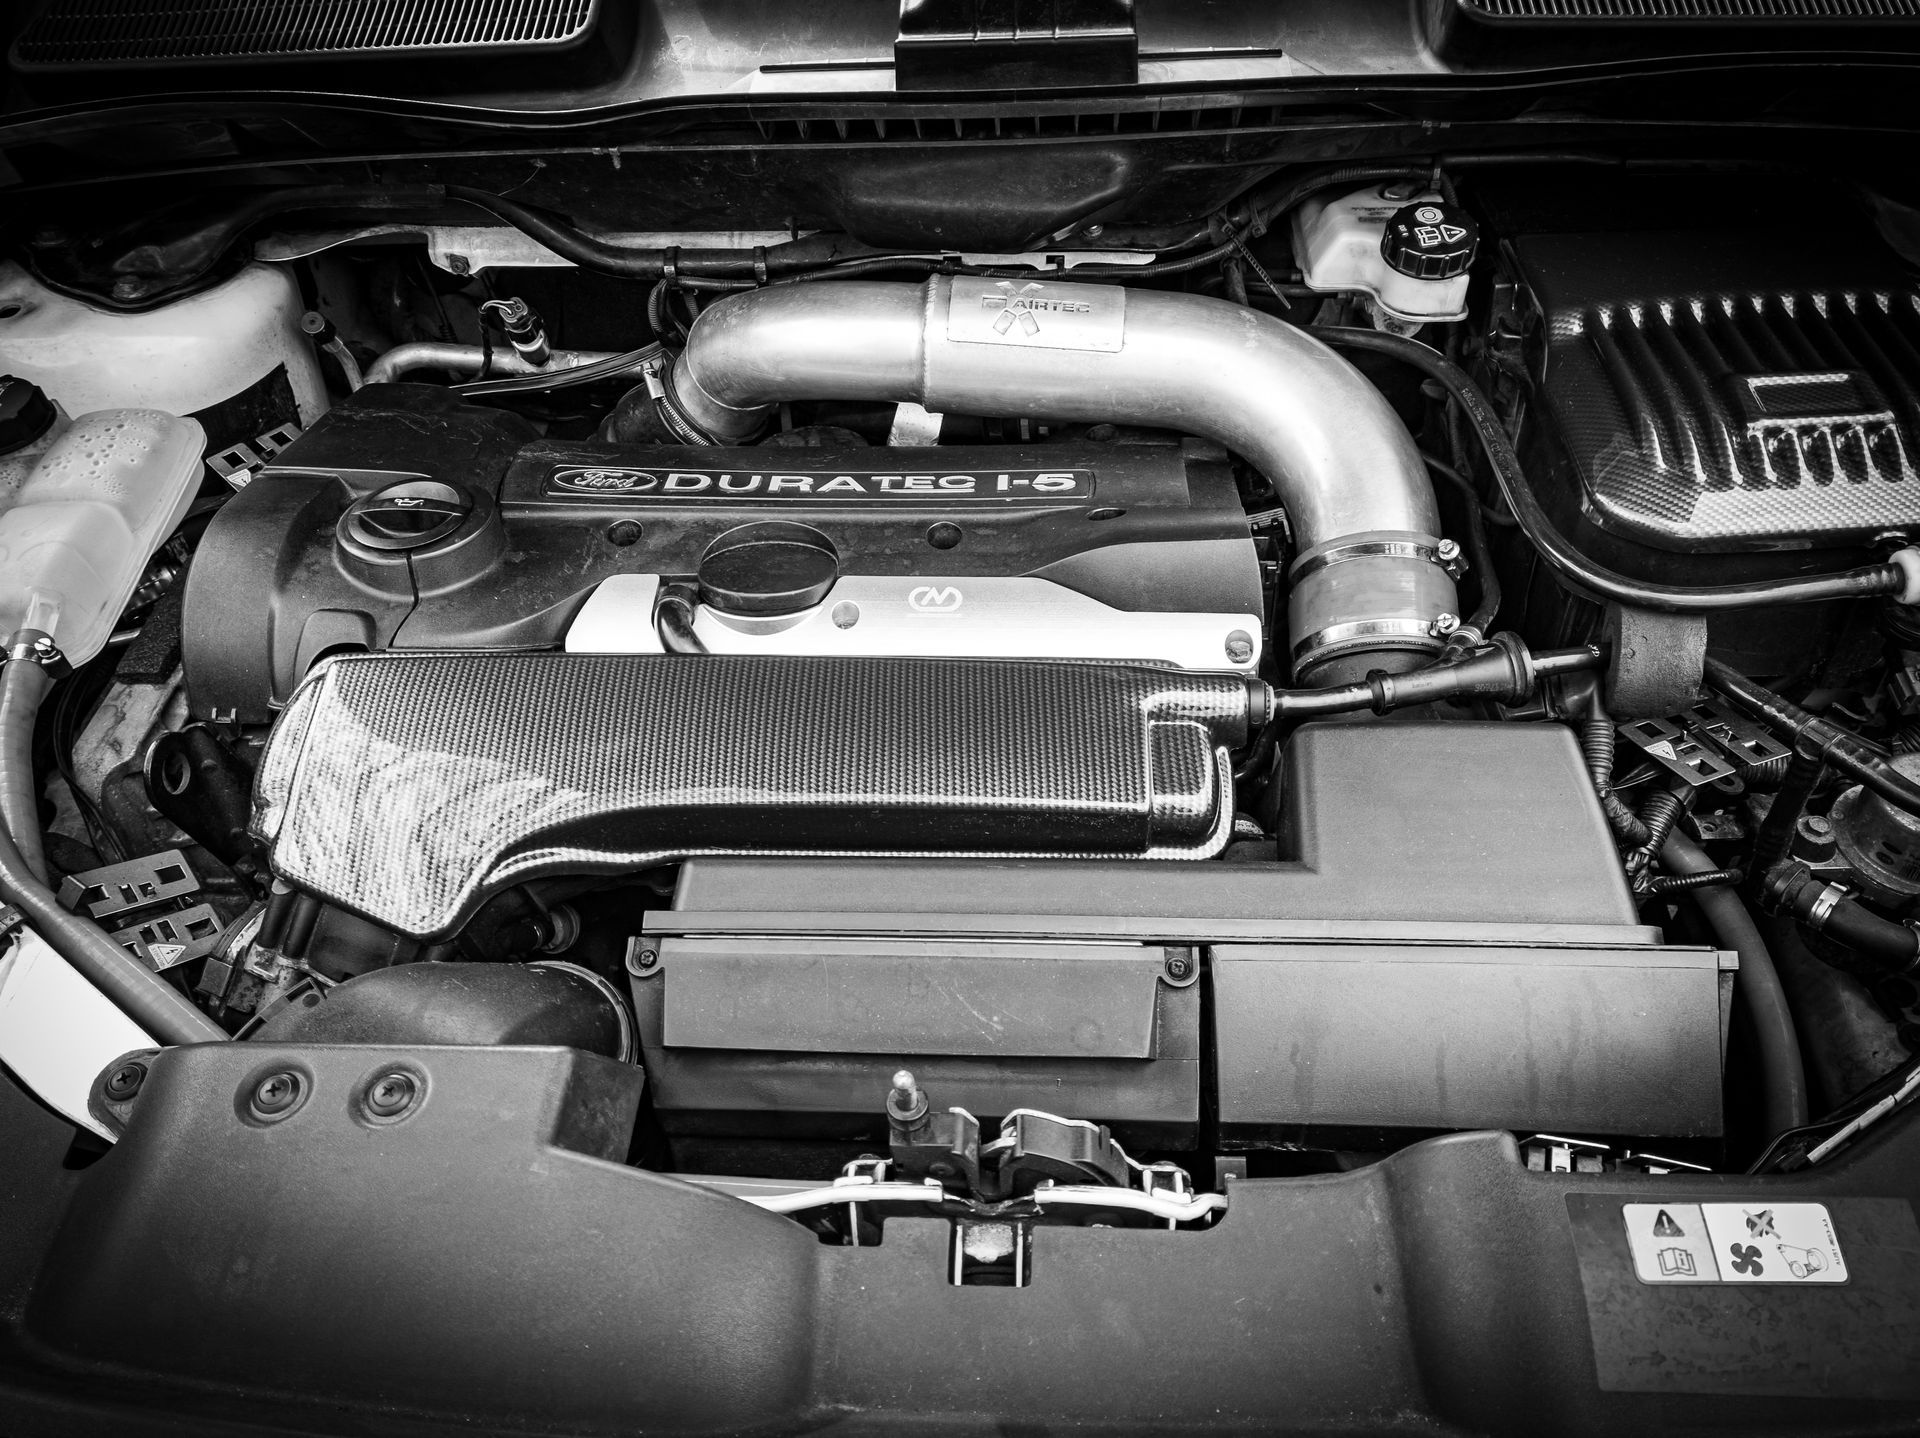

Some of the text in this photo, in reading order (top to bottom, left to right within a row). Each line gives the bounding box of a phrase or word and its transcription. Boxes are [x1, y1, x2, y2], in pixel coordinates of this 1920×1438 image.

[1012, 298, 1090, 313] AIRTEC
[574, 471, 638, 488] Ford
[663, 473, 1077, 493] DURATEC I-5
